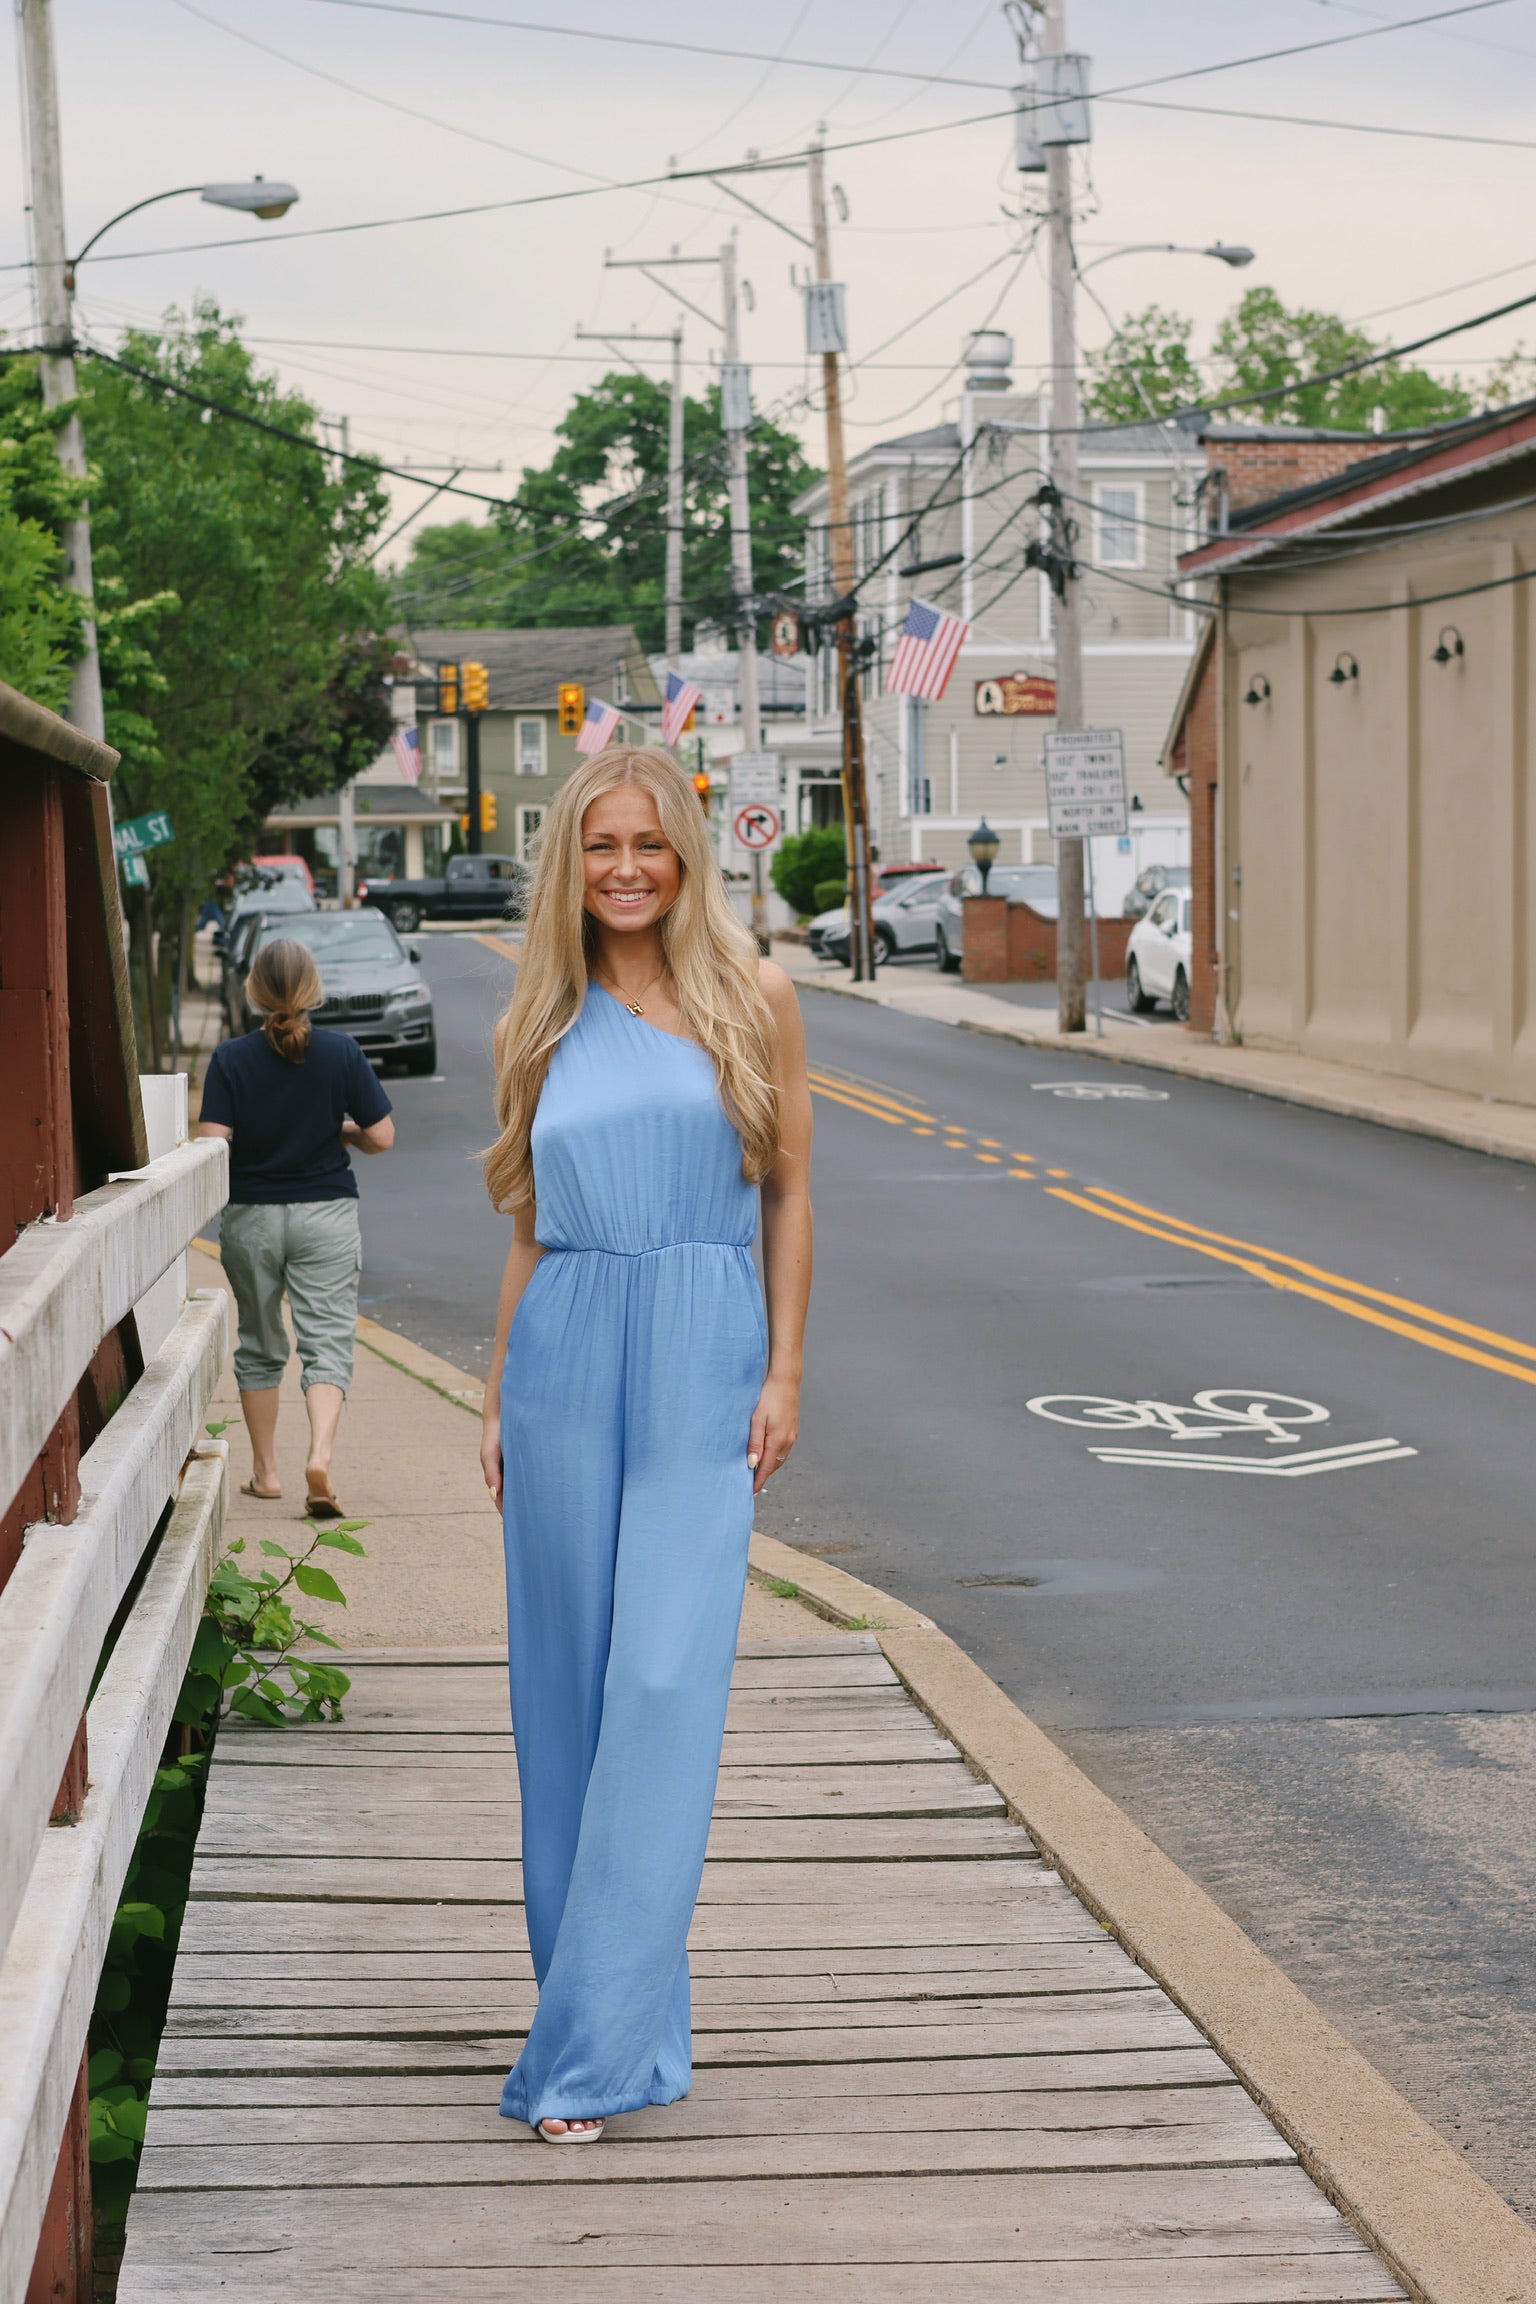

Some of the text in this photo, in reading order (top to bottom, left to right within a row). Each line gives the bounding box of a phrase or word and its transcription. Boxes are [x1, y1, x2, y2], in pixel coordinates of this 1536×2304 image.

[1053, 734, 1113, 745] PROHIBITED
[1076, 769, 1120, 780] TRAILERS
[1050, 786, 1075, 797] OVER
[1062, 805, 1114, 817] NORTH ON
[147, 815, 170, 842] ST
[1056, 821, 1121, 833] MAIN STREET
